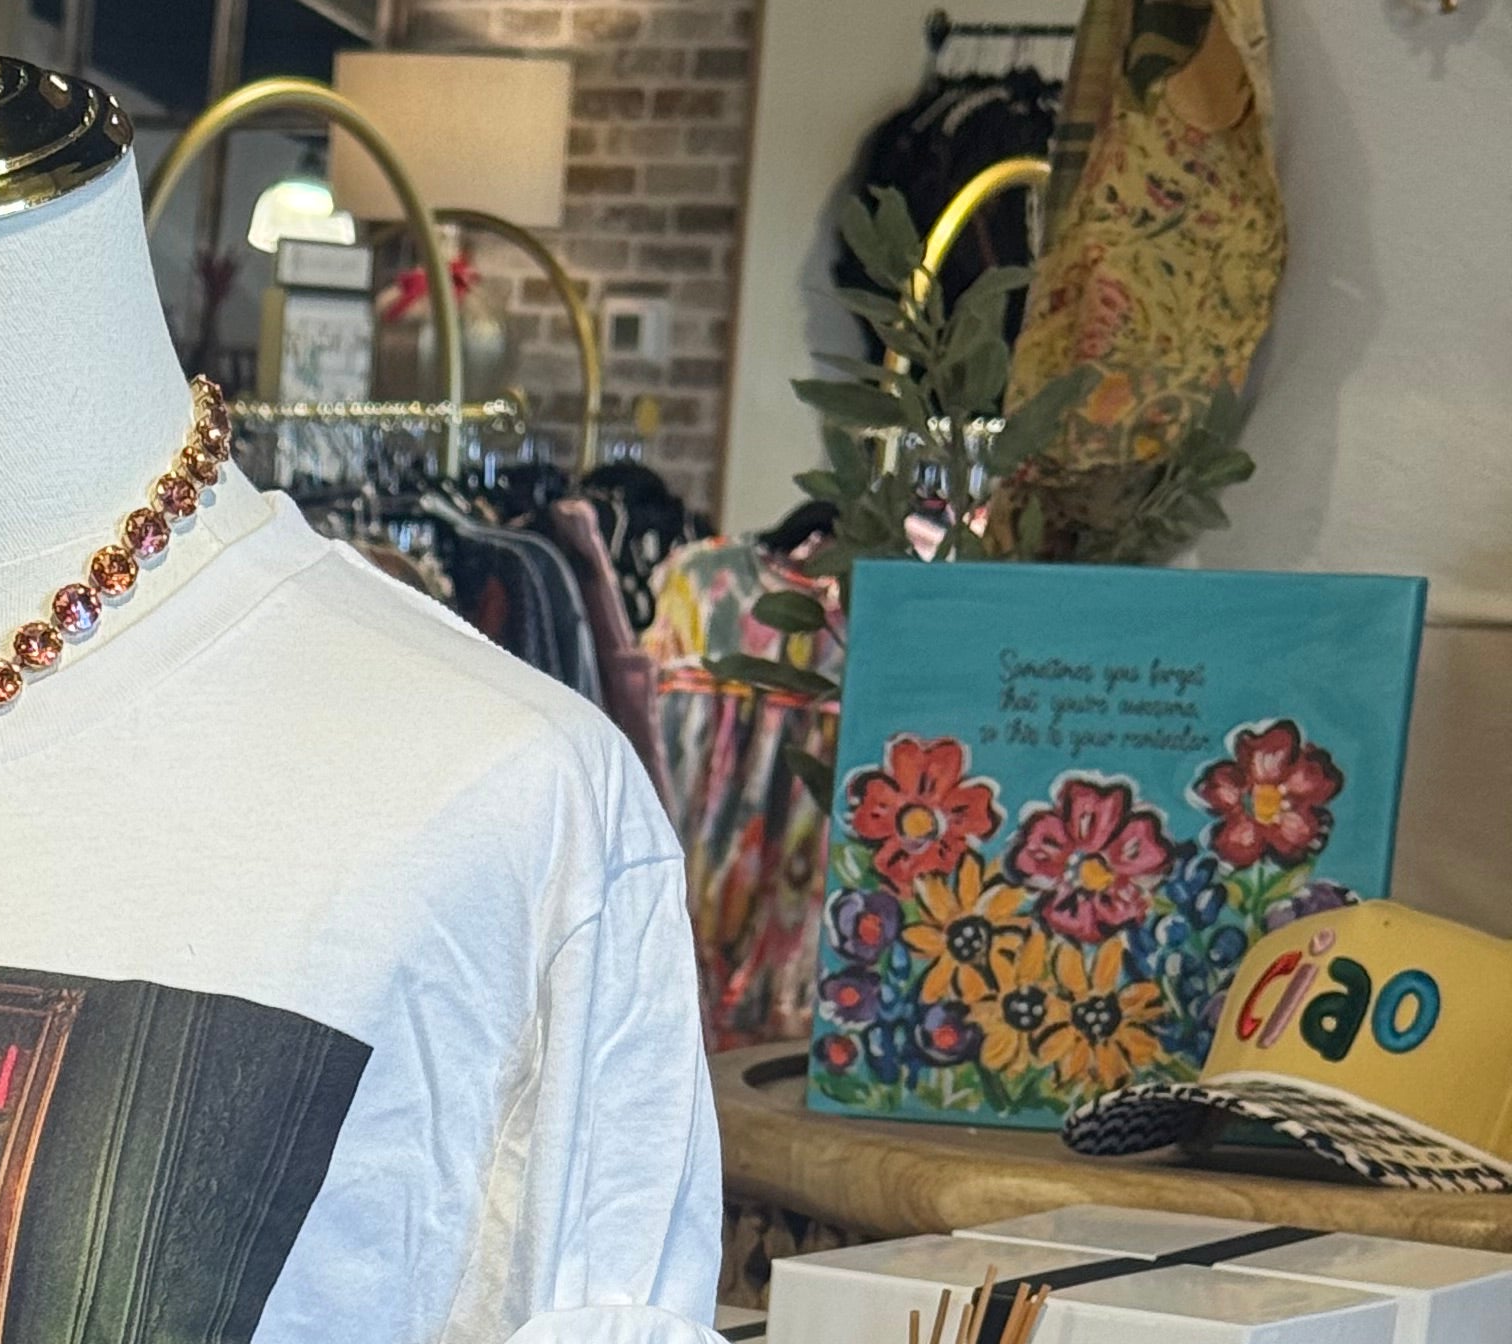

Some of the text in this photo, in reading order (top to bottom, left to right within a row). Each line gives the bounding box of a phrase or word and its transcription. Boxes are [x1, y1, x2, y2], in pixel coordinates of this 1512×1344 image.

[1103, 665, 1140, 693] you
[1149, 657, 1206, 696] forget
[999, 684, 1038, 712] that
[1069, 730, 1115, 759] your
